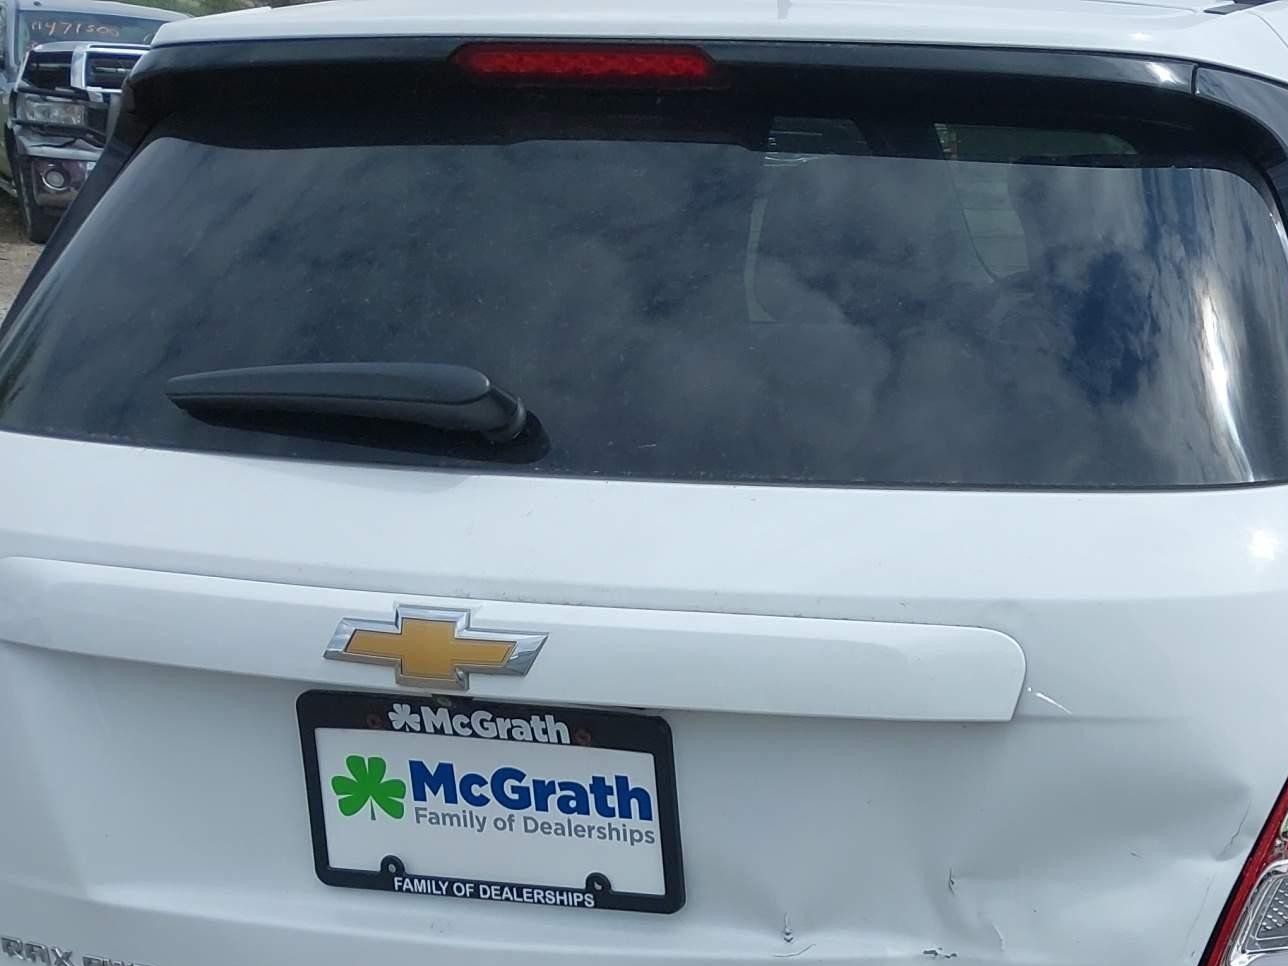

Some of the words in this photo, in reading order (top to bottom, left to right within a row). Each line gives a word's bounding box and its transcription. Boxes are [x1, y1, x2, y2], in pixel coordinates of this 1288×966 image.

[421, 706, 571, 745] McGrath
[408, 760, 654, 822] McGrath
[414, 807, 487, 831] Family
[493, 813, 516, 832] of
[523, 816, 656, 846] Dealerships
[393, 876, 451, 896] FAMILY
[453, 881, 475, 898] OF
[480, 884, 595, 909] DEALERSHIPS
